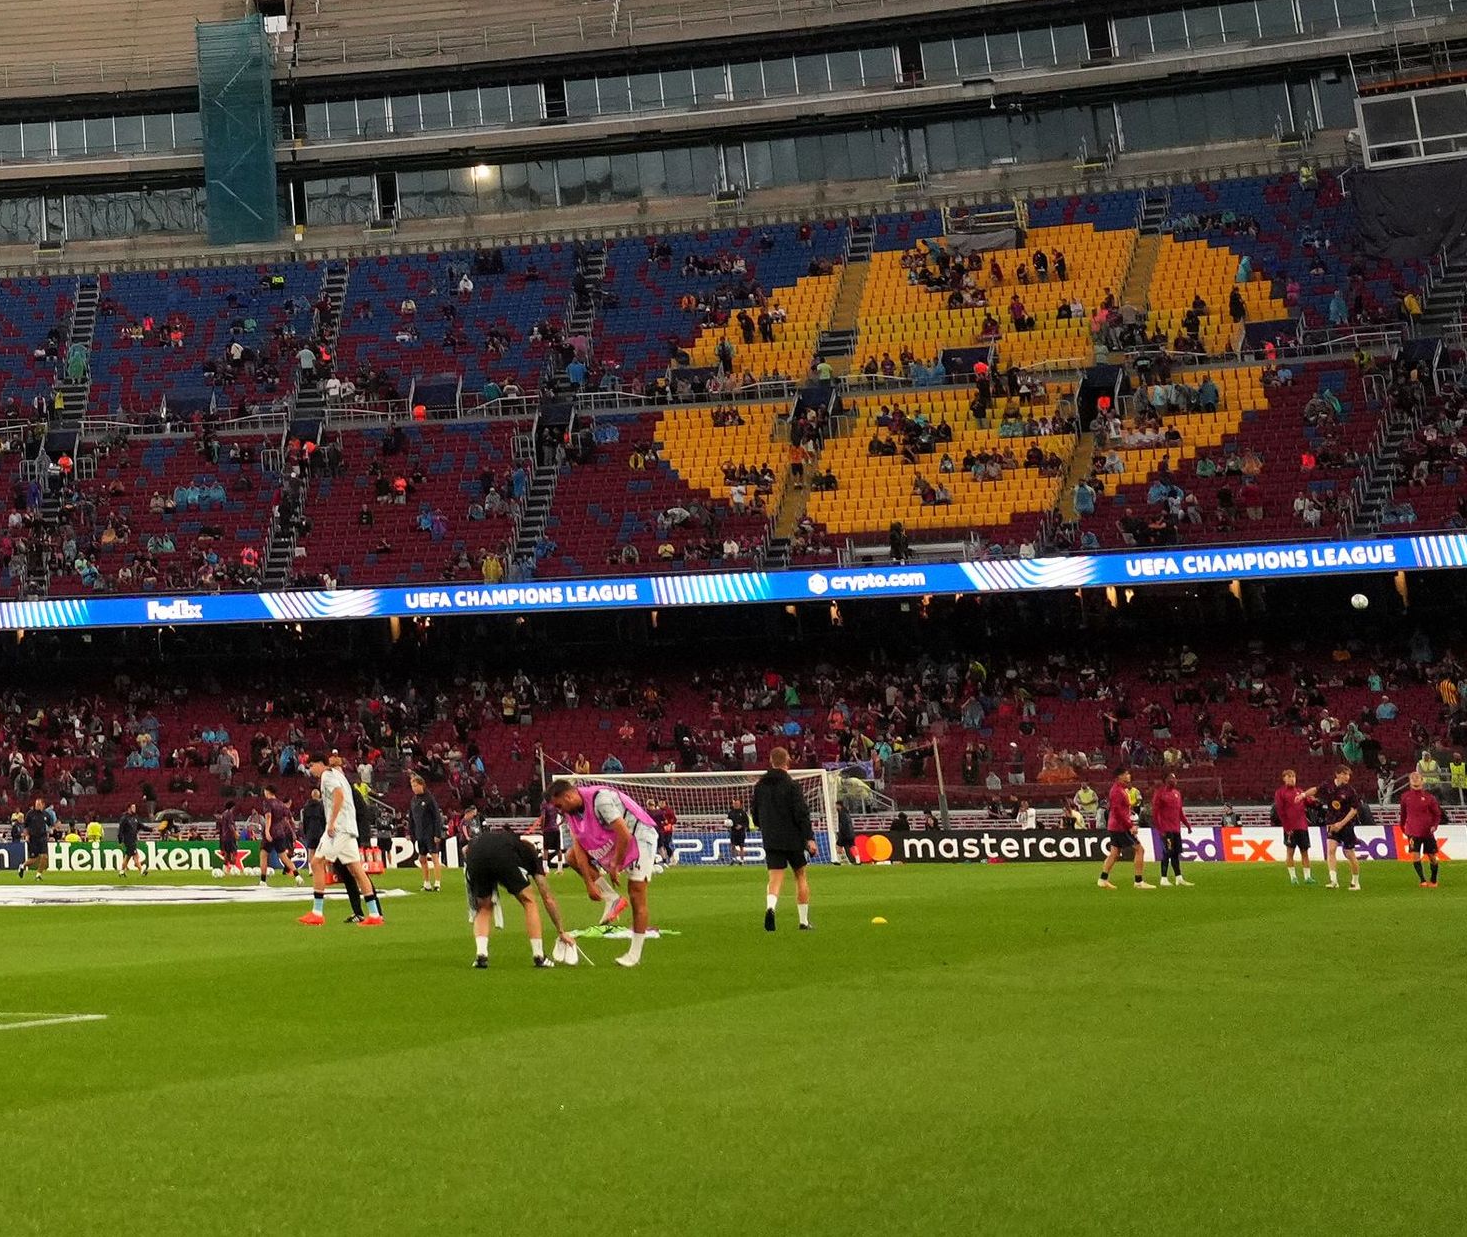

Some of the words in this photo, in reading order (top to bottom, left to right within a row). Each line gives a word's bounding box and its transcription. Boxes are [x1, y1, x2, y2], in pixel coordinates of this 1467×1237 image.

[1125, 558, 1179, 577] UEFA
[1183, 550, 1308, 573] CHAMPIONS
[1311, 544, 1395, 565] LEAGUE
[831, 573, 926, 591] crypto.com
[405, 592, 451, 608] UEFA
[454, 588, 563, 607] CHAMPIONS
[566, 584, 638, 603] LEAGUE
